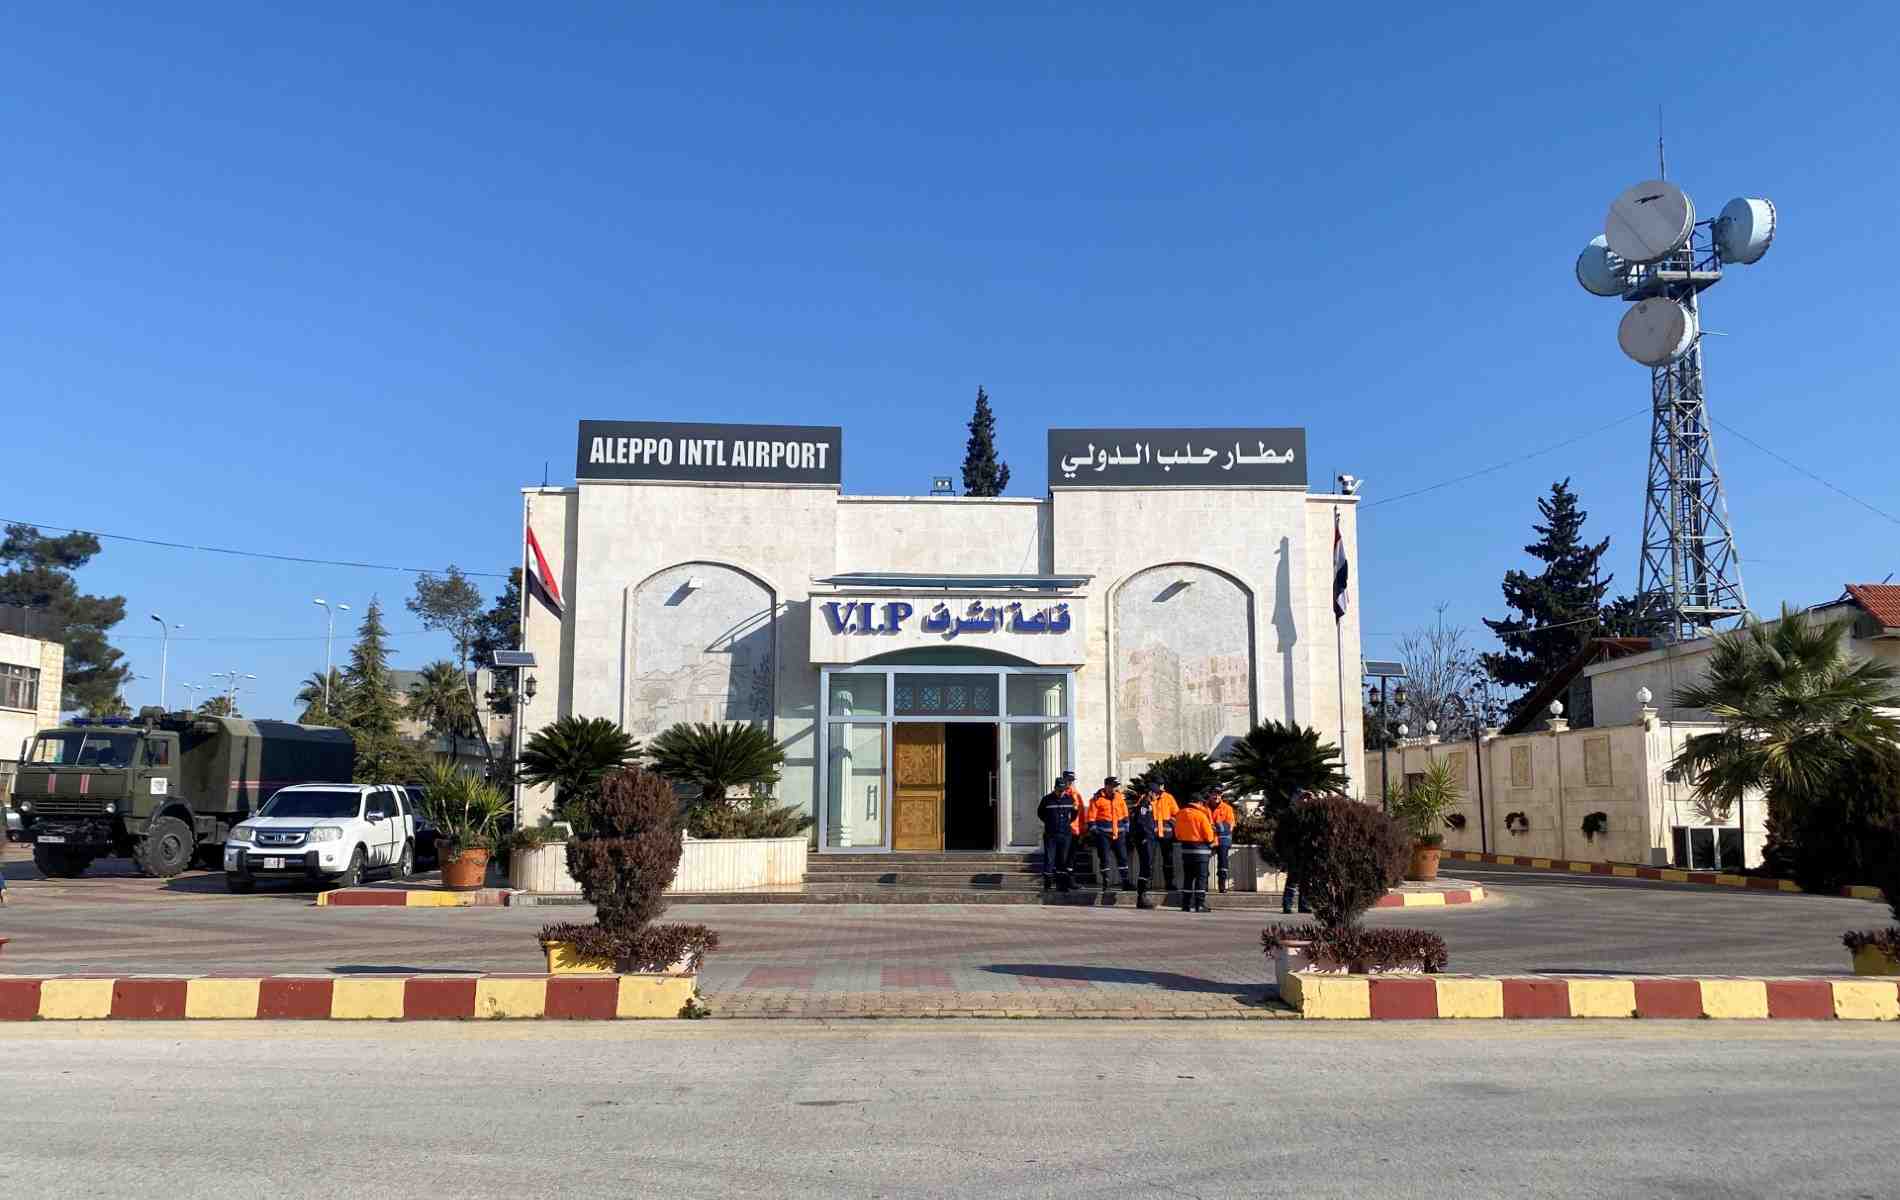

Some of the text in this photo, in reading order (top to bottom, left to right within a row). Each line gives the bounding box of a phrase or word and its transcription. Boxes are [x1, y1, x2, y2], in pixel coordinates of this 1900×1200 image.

[589, 436, 830, 469] ALEPPO INTL AIRPORT
[1060, 441, 1295, 478] مطار حلب الدولي
[821, 601, 913, 635] V.I.P
[921, 600, 1071, 641] قاعة الشرف
